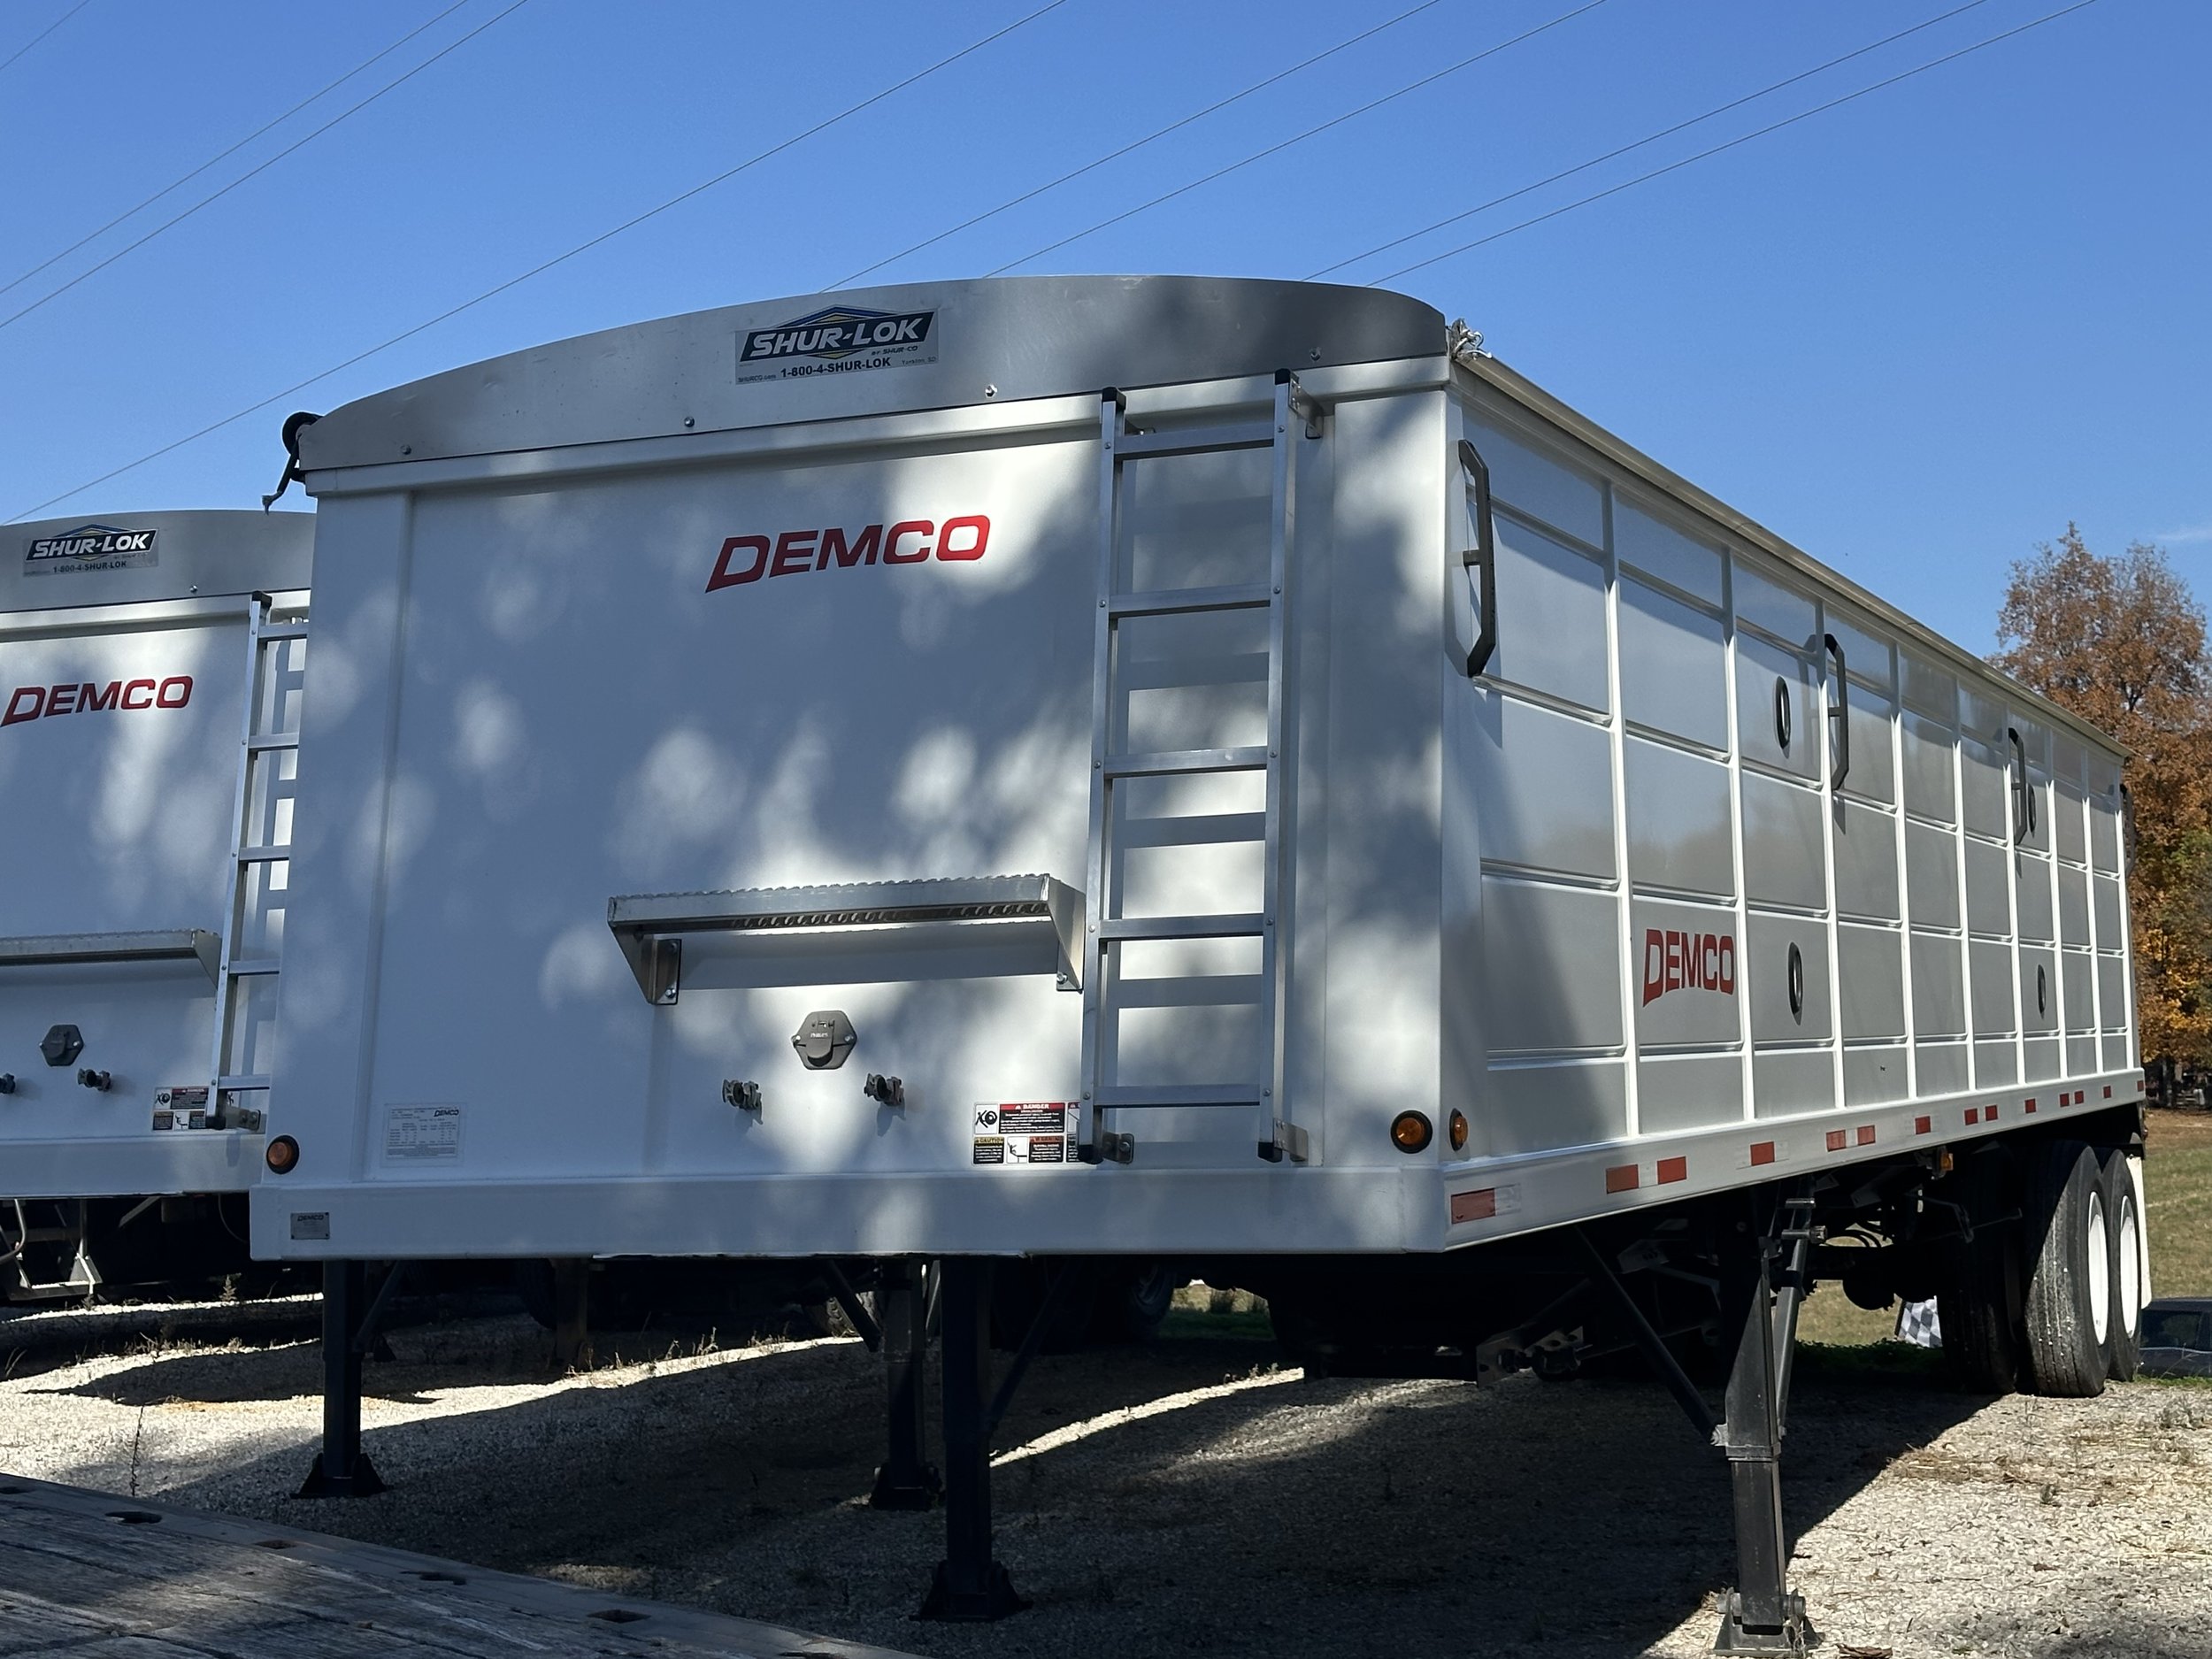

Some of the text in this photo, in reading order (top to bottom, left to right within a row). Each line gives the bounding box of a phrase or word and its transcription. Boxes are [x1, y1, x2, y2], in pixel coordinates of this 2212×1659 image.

[750, 317, 924, 357] SHUR-LOK
[780, 357, 891, 378] 1-800-4-SHUR-LOK
[33, 533, 150, 558] SHUR-LOK
[705, 514, 990, 593] DEMCO
[53, 560, 127, 574] 1-800-4-SHUR-LOK
[0, 676, 193, 727] DEMCO
[1642, 928, 1734, 1008] DEMCO
